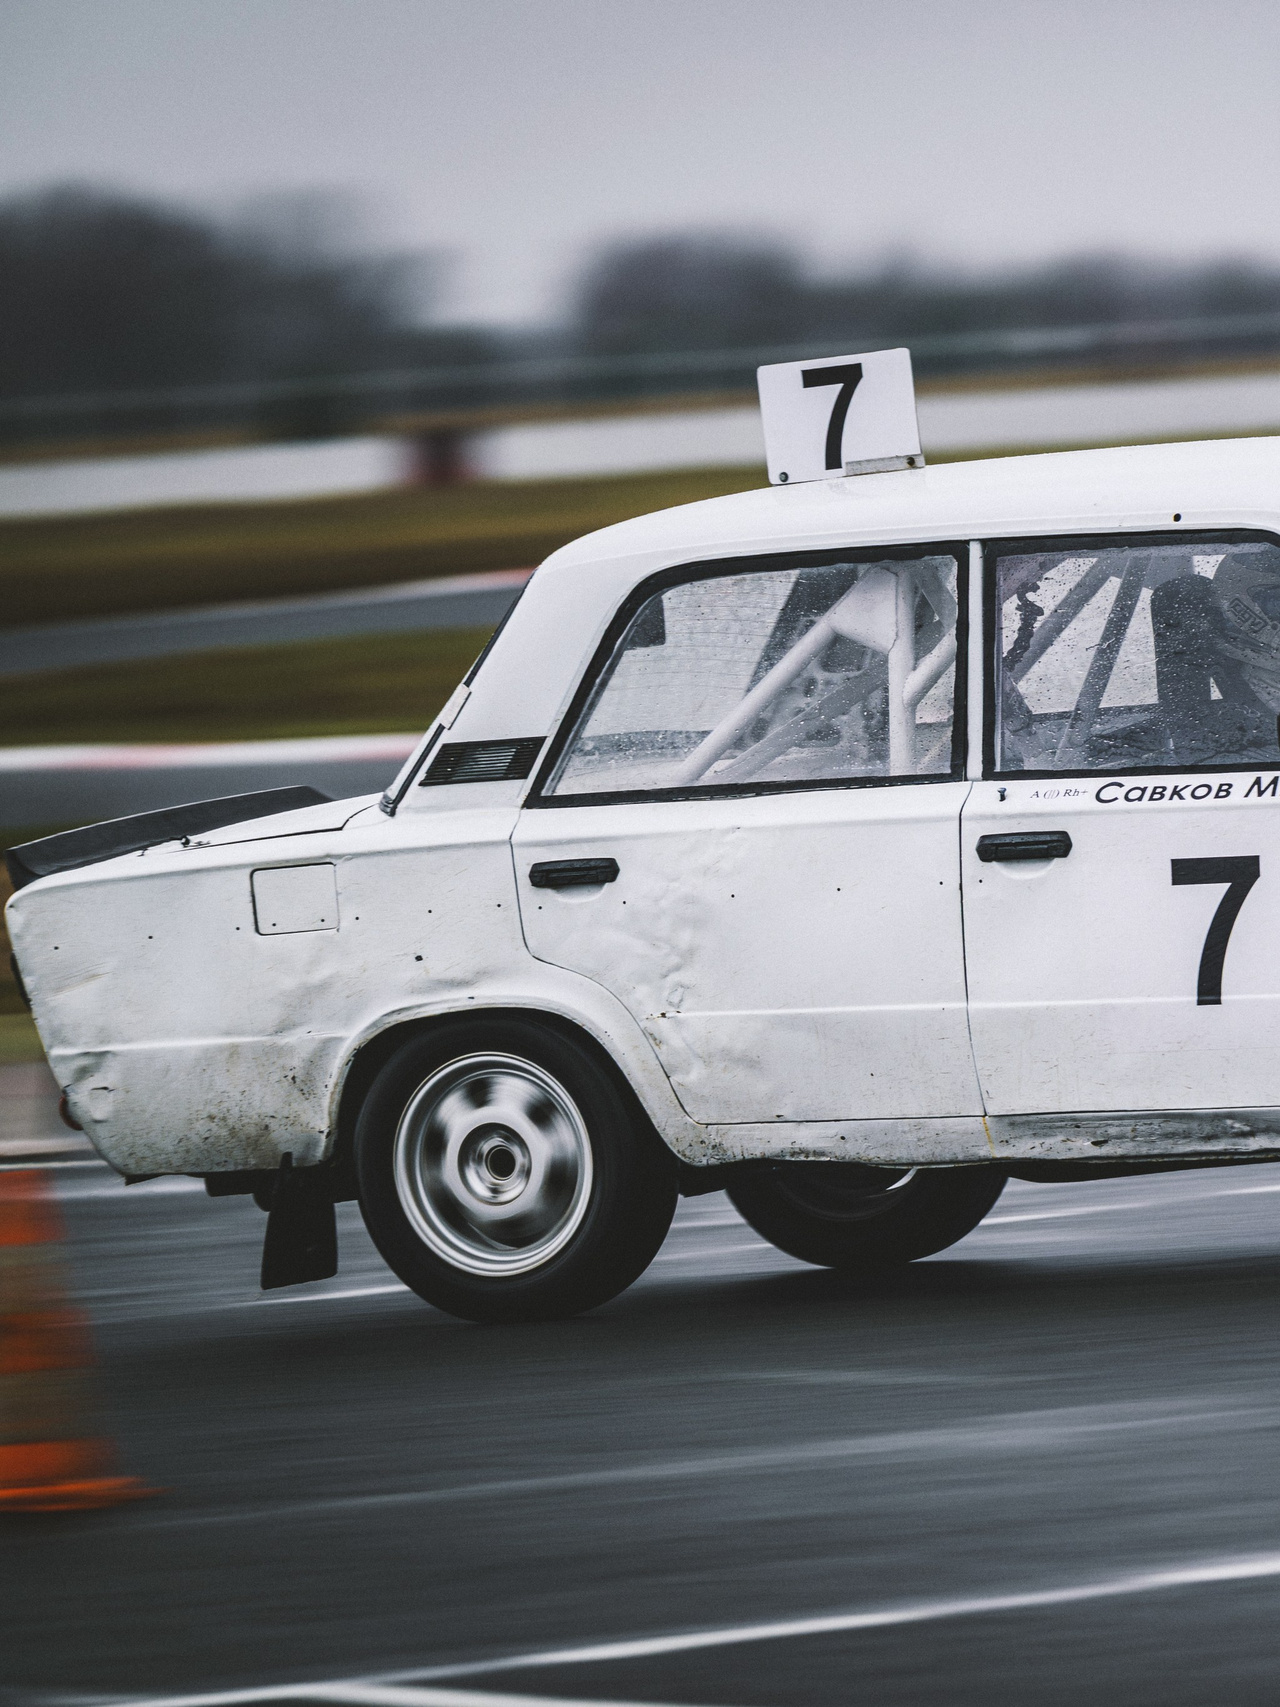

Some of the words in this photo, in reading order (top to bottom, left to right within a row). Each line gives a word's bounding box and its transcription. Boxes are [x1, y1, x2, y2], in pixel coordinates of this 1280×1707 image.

[801, 362, 863, 471] 7
[1030, 790, 1040, 799] A
[1063, 788, 1089, 798] Rh+
[1095, 781, 1234, 804] Савков
[1171, 855, 1260, 1005] 7
